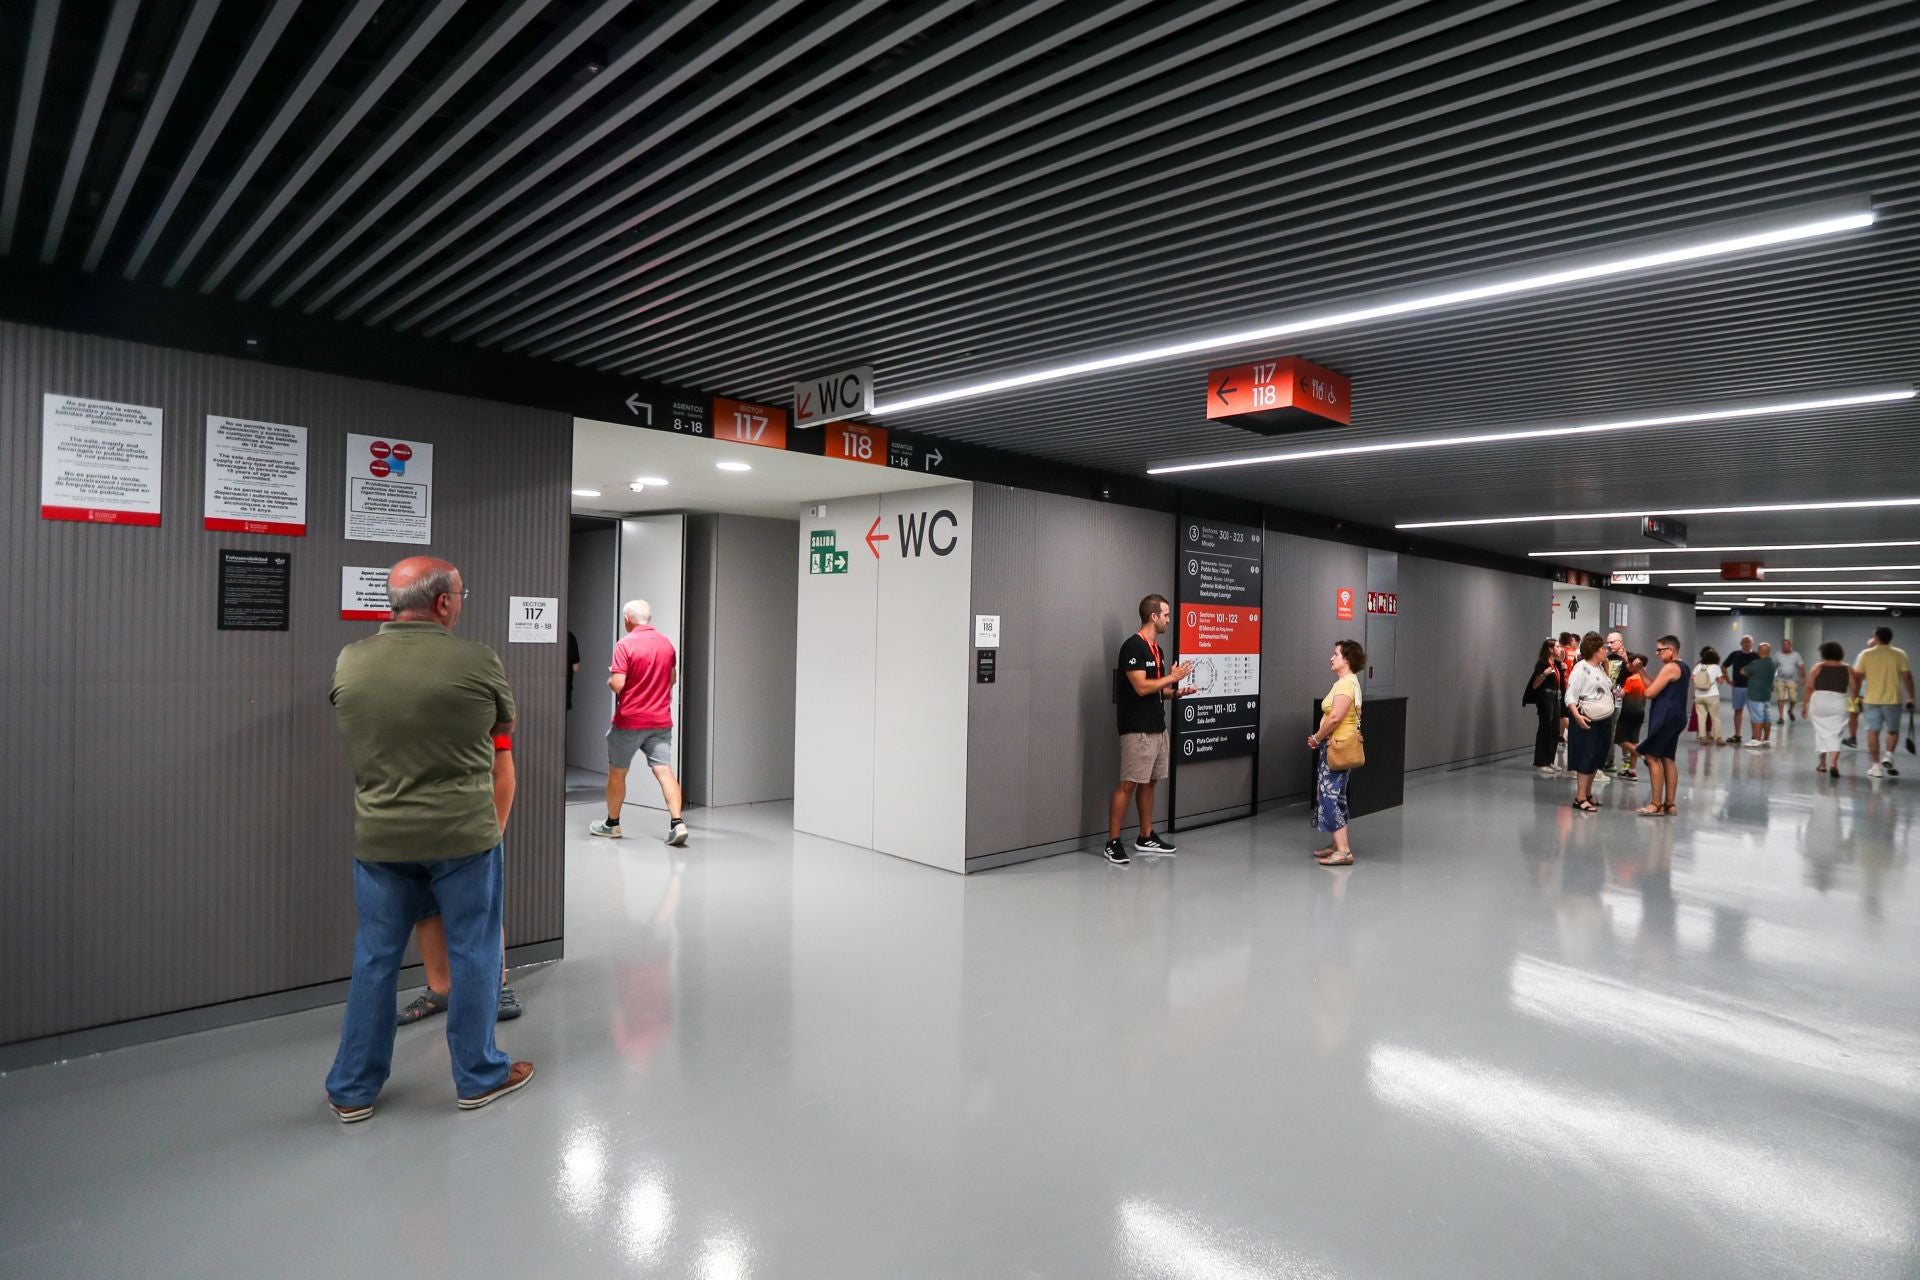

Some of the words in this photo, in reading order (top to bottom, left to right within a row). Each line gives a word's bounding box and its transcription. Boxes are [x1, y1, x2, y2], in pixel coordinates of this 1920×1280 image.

[1253, 363, 1277, 384] 117
[818, 374, 860, 414] WC
[1252, 385, 1276, 407] 118
[673, 402, 703, 413] ASIENTOS
[739, 405, 763, 414] SECTOR
[673, 418, 682, 429] 8
[691, 421, 703, 433] 18
[734, 412, 768, 441] 117
[842, 432, 872, 459] 118
[900, 457, 909, 467] 14
[898, 510, 958, 558] WC
[1219, 530, 1229, 540] 301
[1233, 532, 1244, 542] 323
[812, 536, 835, 547] SALIDA
[525, 608, 543, 620] 117
[1229, 614, 1238, 623] 122
[1214, 704, 1222, 714] 101
[1226, 703, 1236, 712] 103
